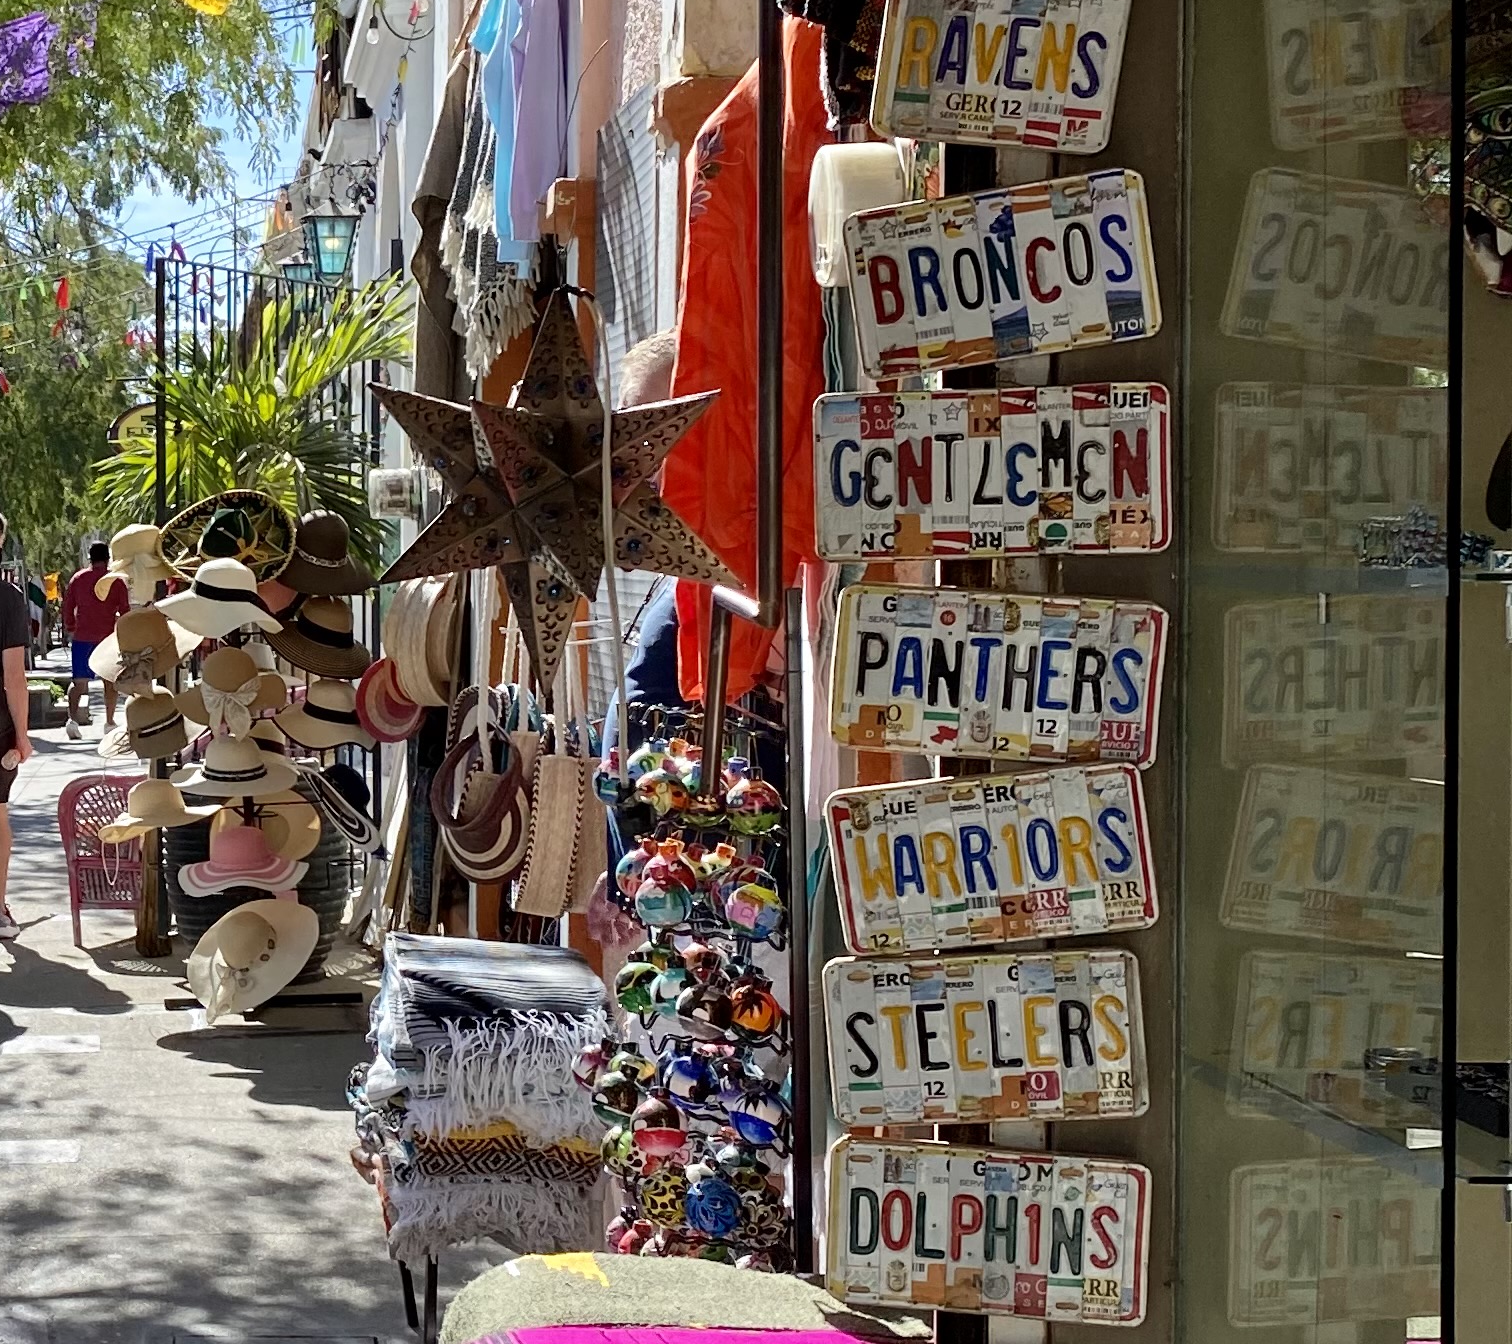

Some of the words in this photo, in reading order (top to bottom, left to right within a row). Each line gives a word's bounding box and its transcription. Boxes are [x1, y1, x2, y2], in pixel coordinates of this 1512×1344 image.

[899, 16, 1107, 99] RAVENS
[1001, 99, 1022, 116] 12
[868, 214, 1133, 325] BRONCOS
[830, 419, 1148, 510] GENTLEMEN
[856, 632, 1143, 715] PANTHERS
[1036, 718, 1057, 734] 12
[870, 933, 890, 948] 12
[847, 994, 1127, 1078] STEELERS
[924, 1081, 946, 1096] 12
